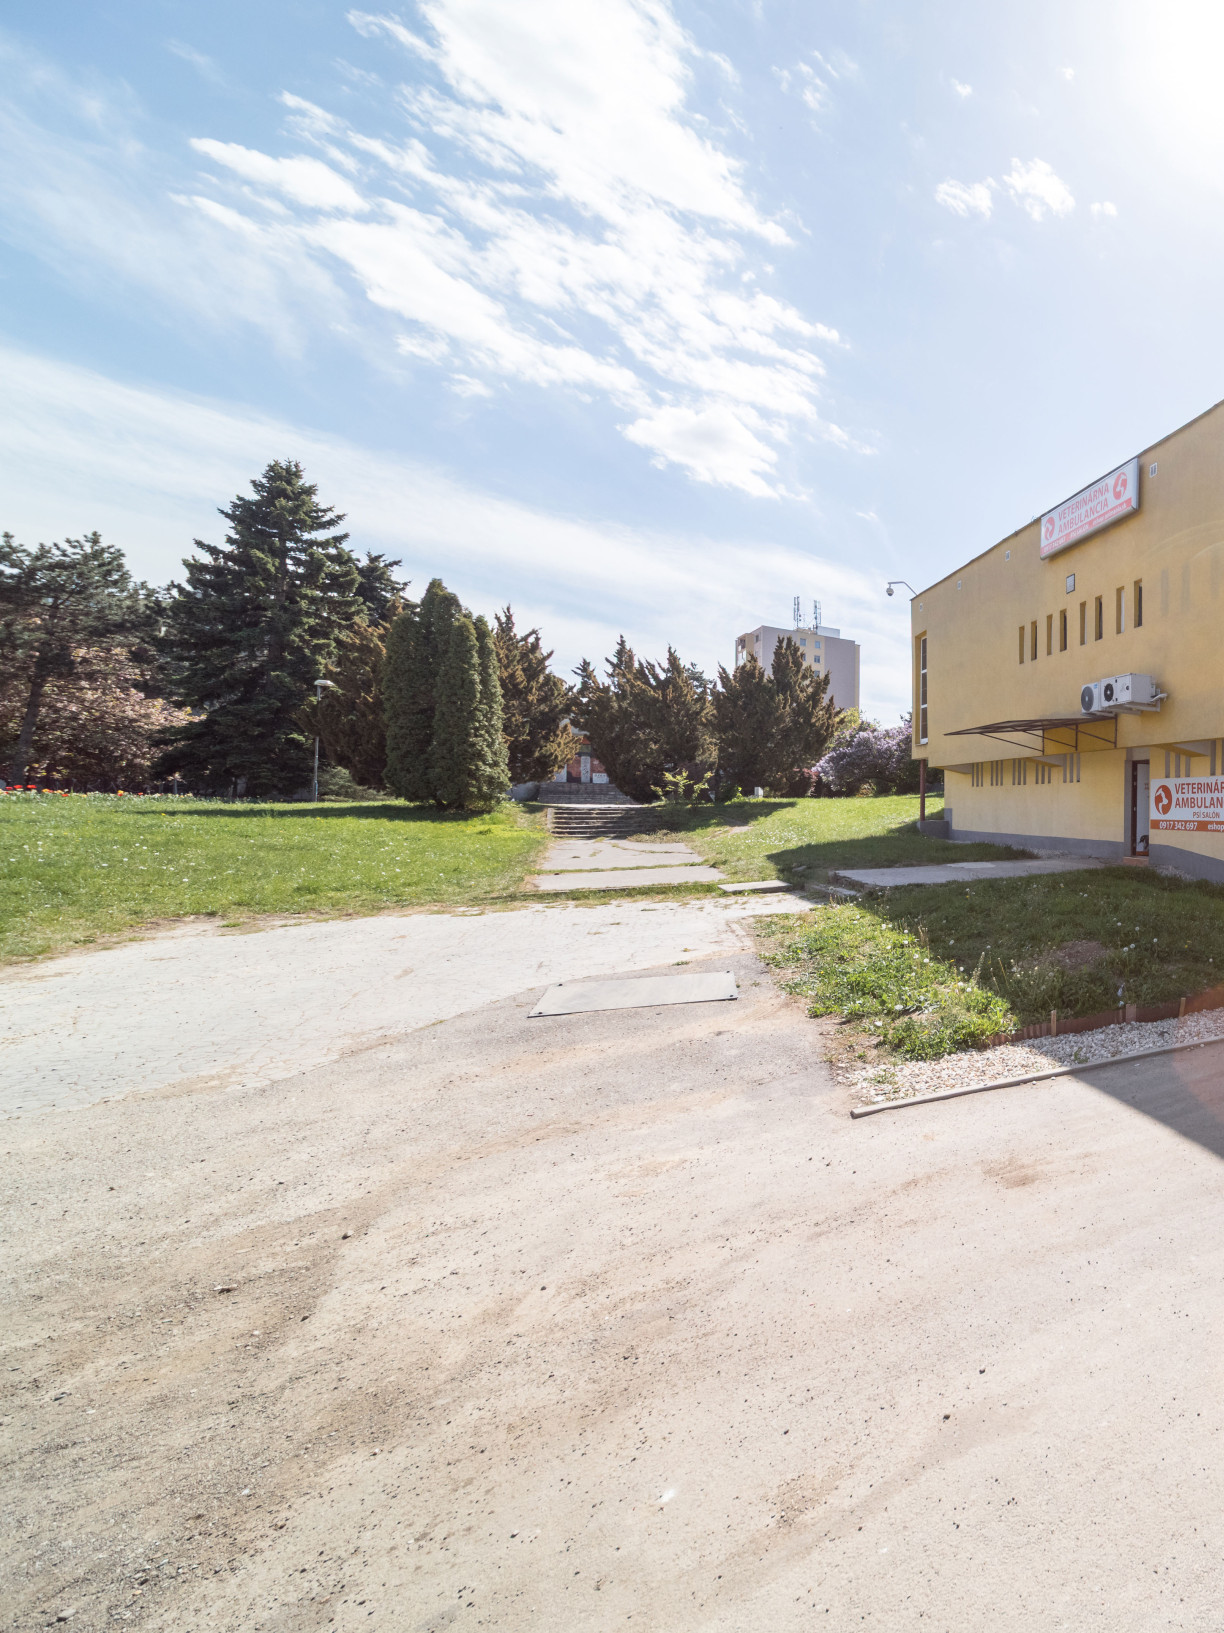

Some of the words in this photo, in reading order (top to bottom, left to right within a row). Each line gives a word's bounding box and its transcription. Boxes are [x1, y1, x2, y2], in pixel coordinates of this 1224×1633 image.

[1058, 482, 1109, 522] VETERINÁRNA
[1058, 498, 1109, 536] AMBULANCIA
[1159, 821, 1173, 830] 0917
[1174, 822, 1185, 830] 342
[1186, 822, 1198, 831] 697
[1192, 811, 1202, 819] PSÍ
[1202, 811, 1220, 819] SALÓN
